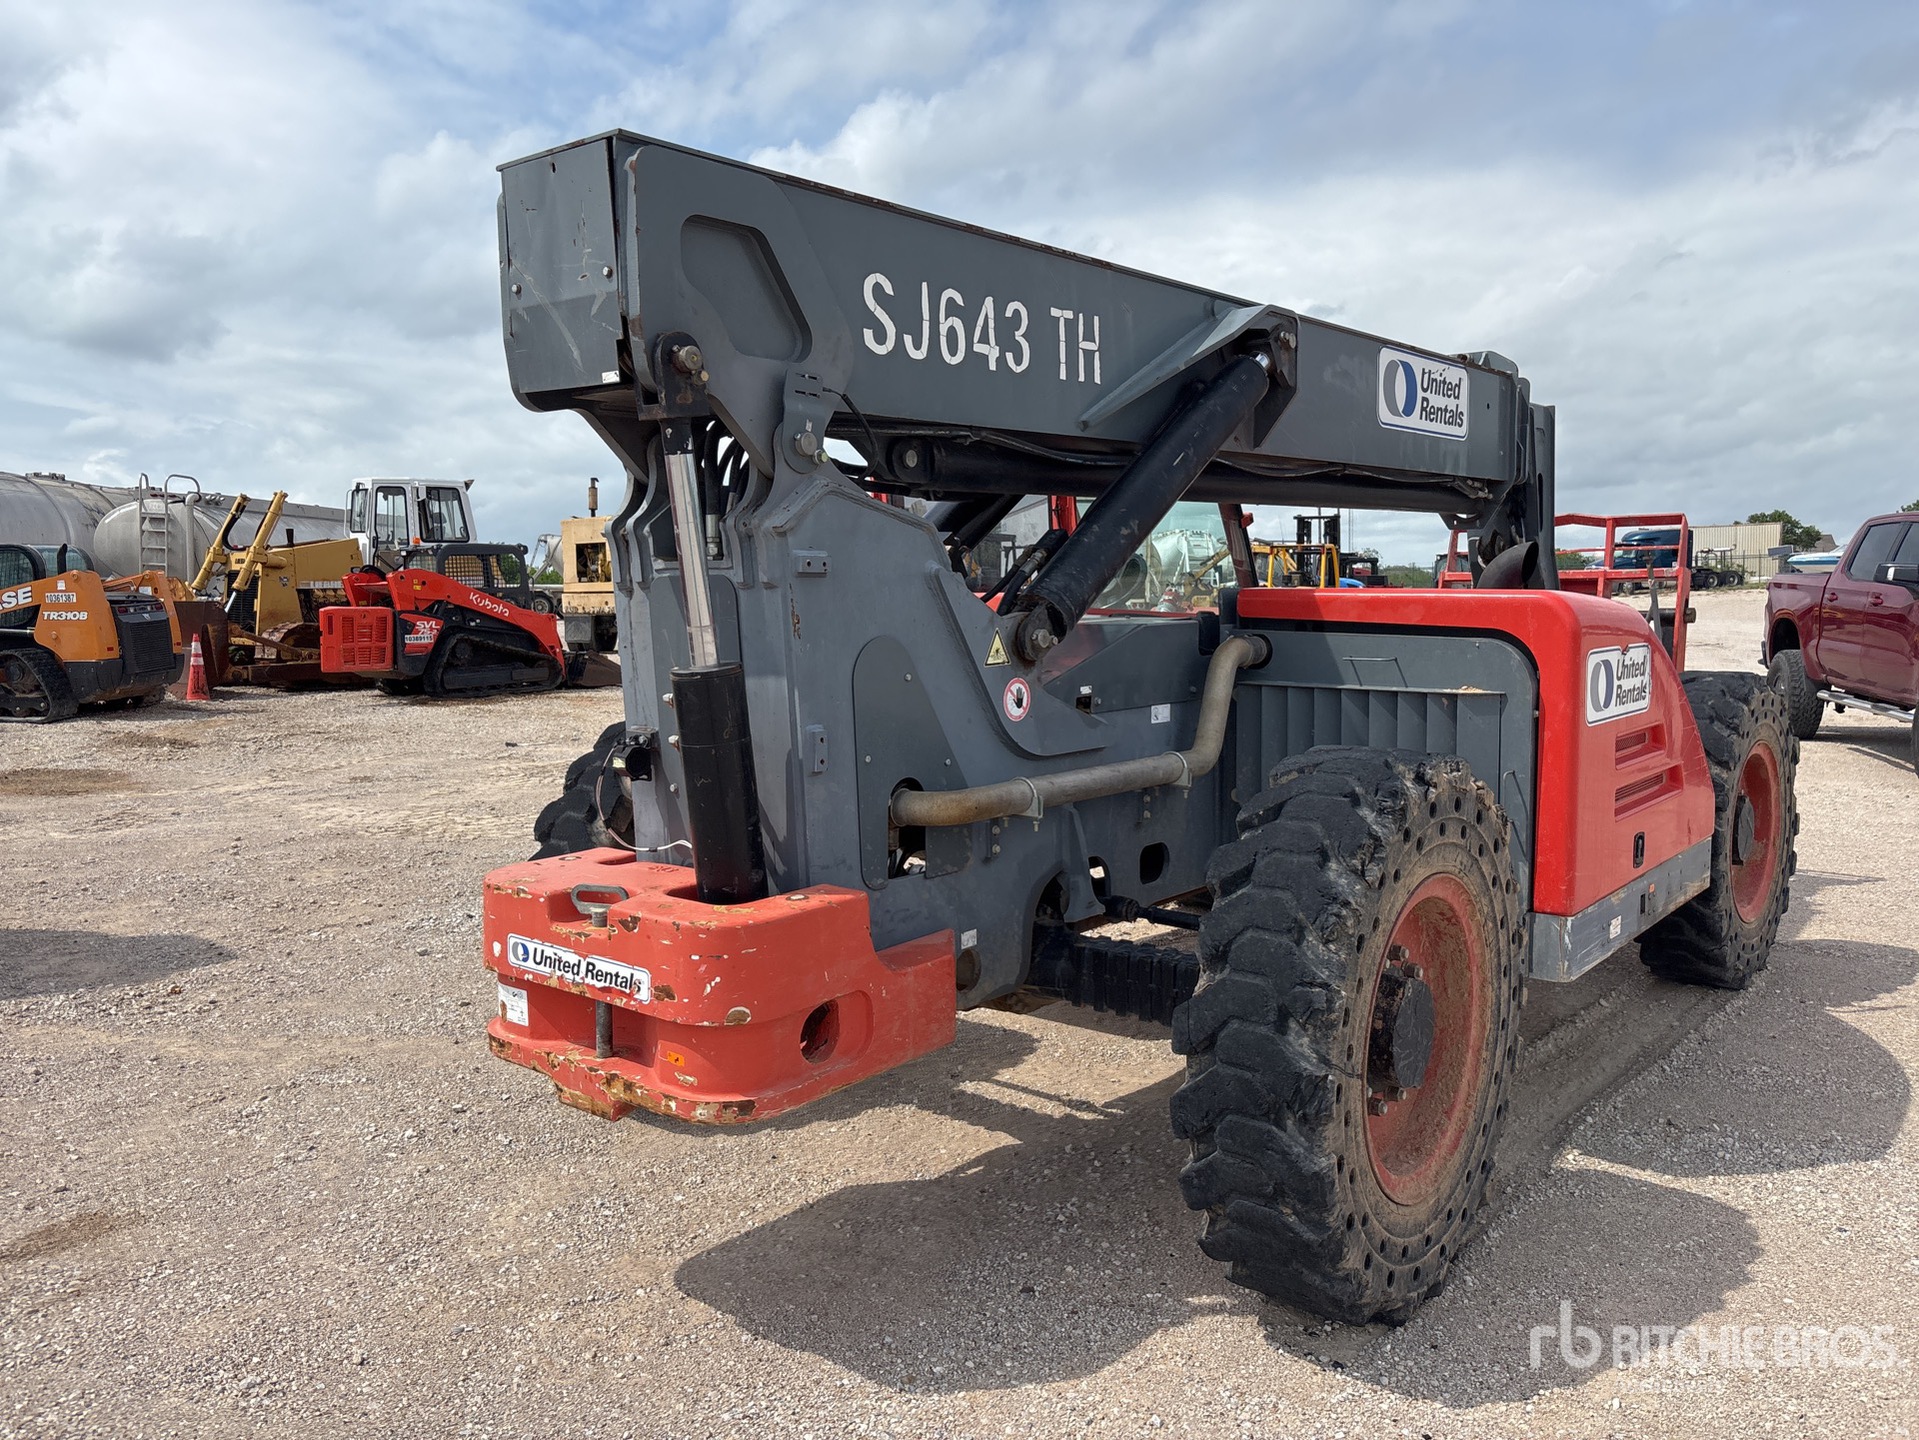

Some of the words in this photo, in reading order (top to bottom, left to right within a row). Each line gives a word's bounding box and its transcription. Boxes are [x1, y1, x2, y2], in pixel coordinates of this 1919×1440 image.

[862, 272, 1031, 374] SJ643
[1049, 306, 1101, 385] TH
[1420, 368, 1463, 400] United
[1419, 397, 1464, 428] Rentals
[42, 611, 88, 621] TR310B
[469, 591, 510, 617] Kubota
[415, 620, 441, 629] SVL
[1616, 655, 1647, 681] United
[1615, 680, 1647, 707] Rentals
[532, 947, 582, 977] United
[584, 958, 643, 994] Rentals
